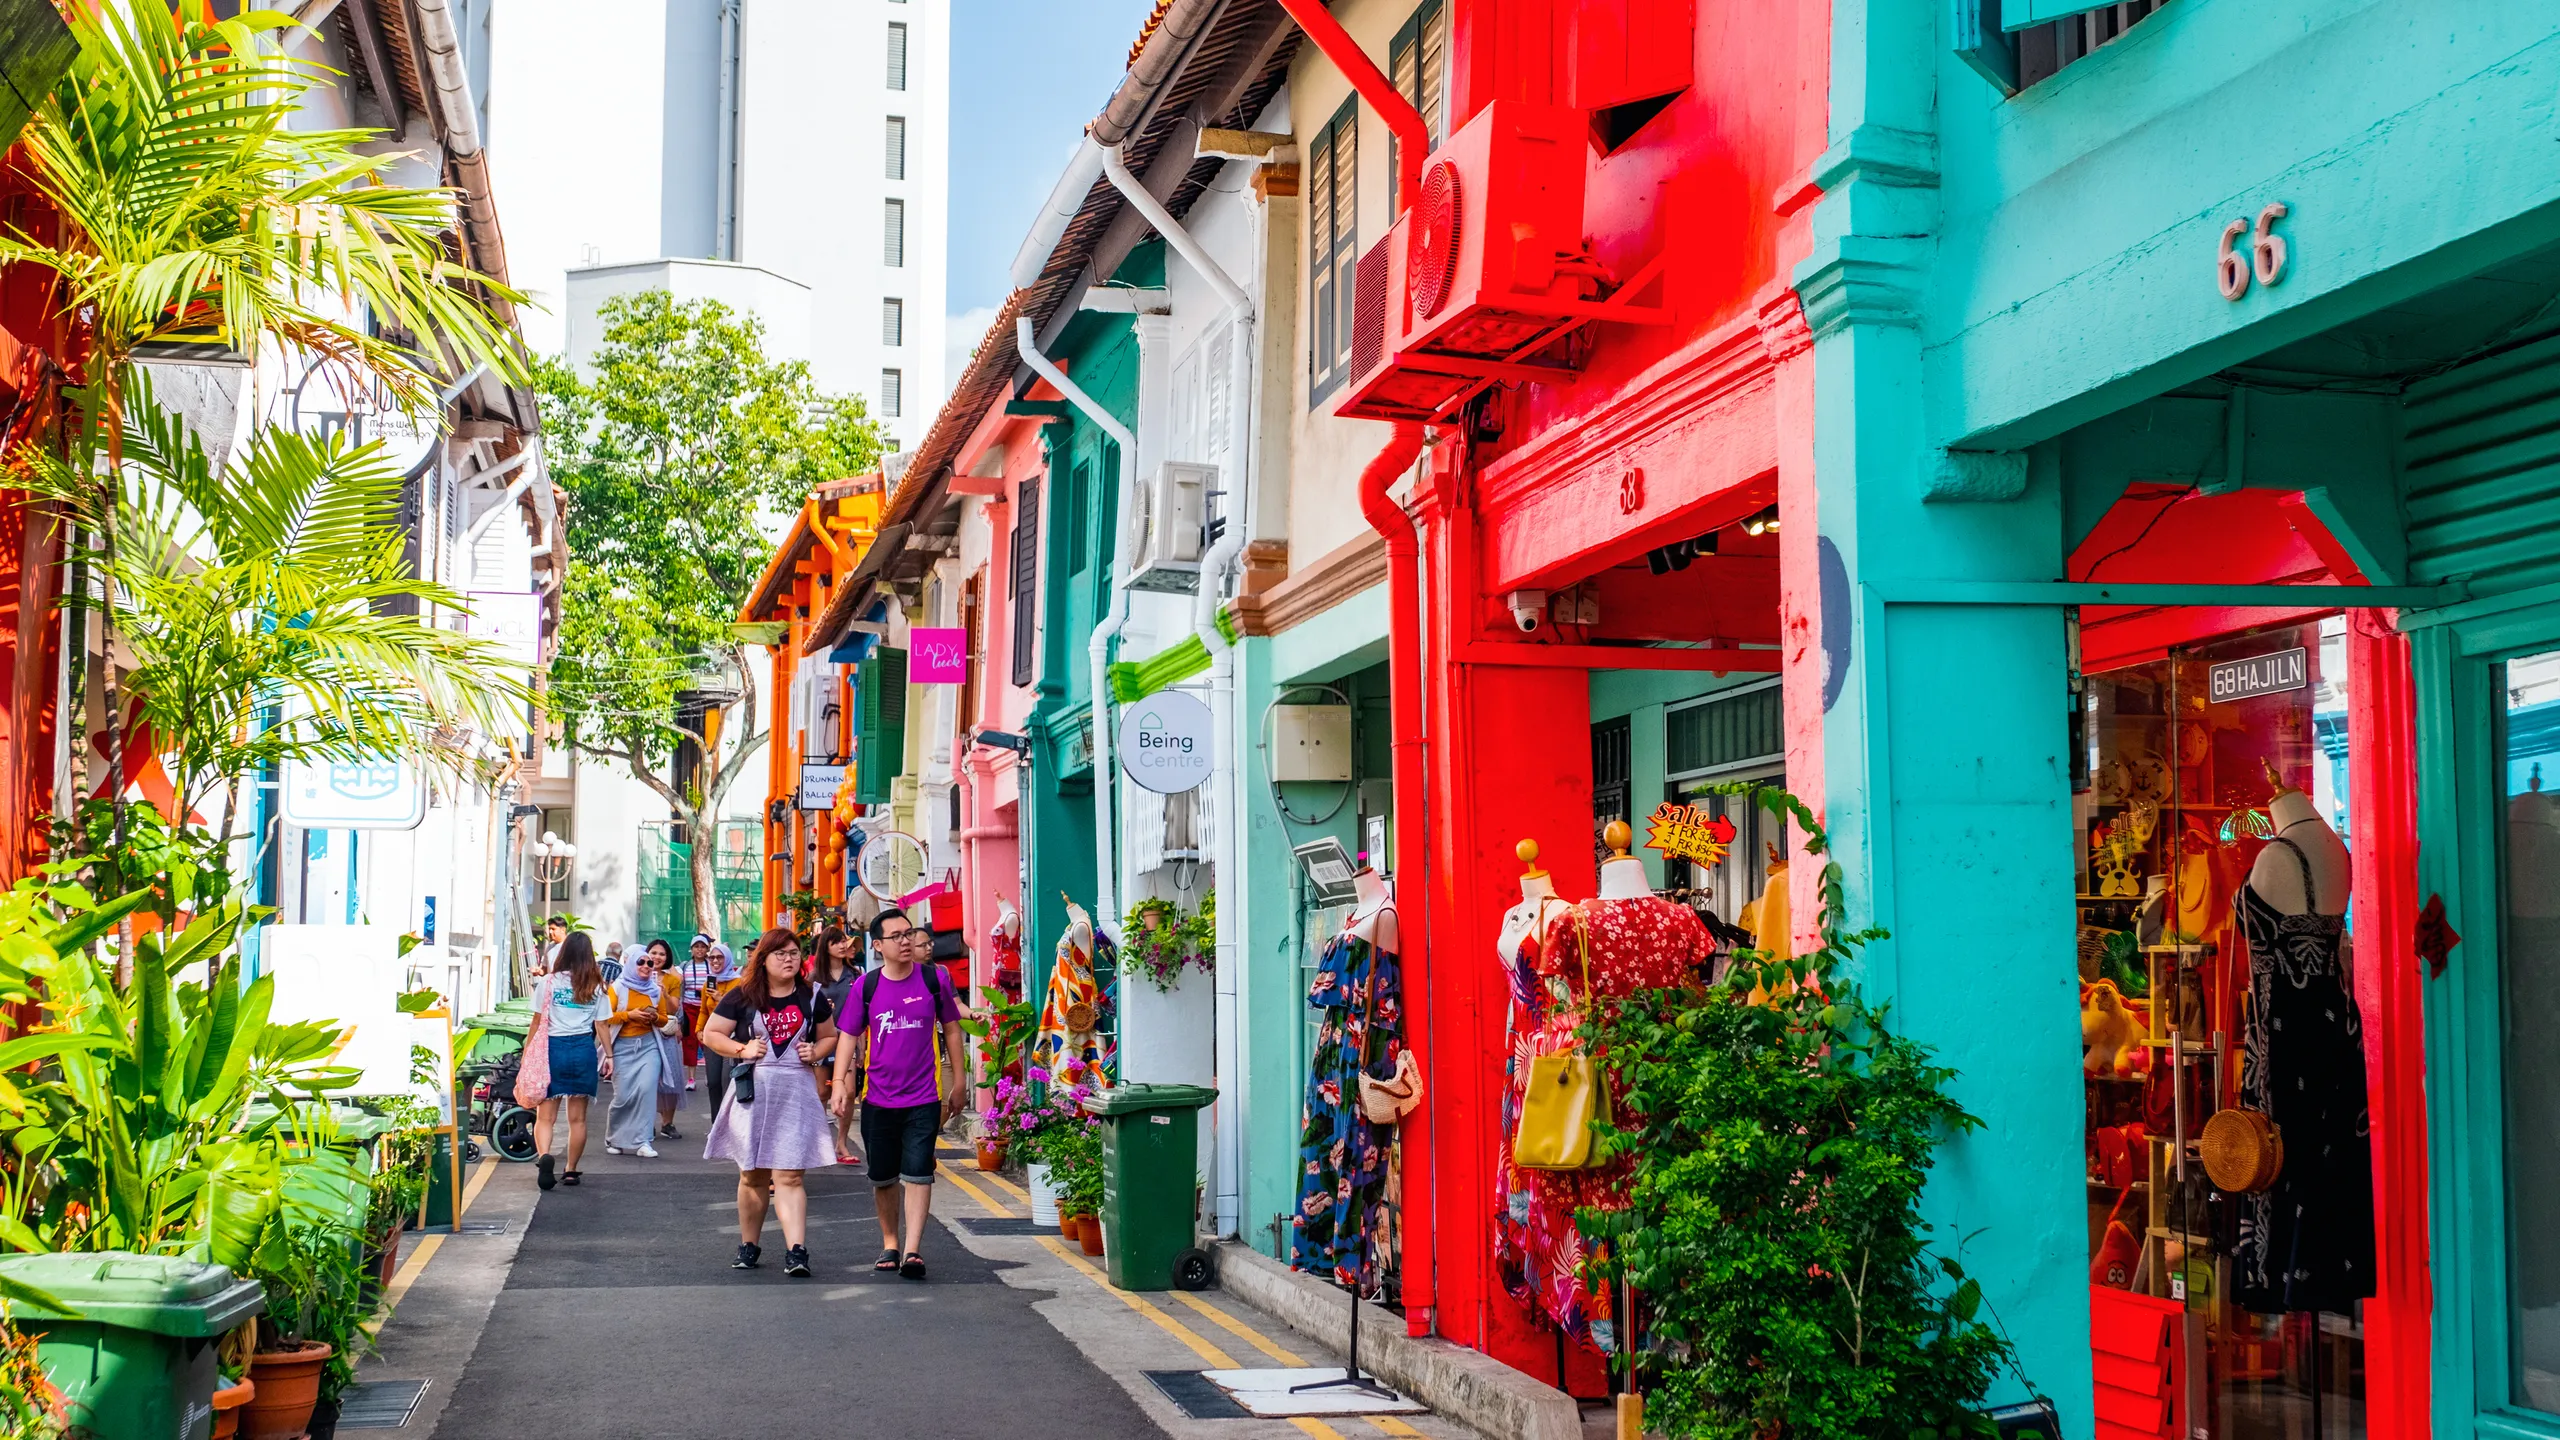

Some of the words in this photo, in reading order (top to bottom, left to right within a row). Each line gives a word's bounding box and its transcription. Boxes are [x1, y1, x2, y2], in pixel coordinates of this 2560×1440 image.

[2217, 202, 2288, 300] 66
[915, 643, 957, 657] LADY
[932, 652, 963, 669] luck
[2214, 654, 2301, 696] 68HAJILN
[1139, 732, 1193, 753] Being
[1139, 751, 1204, 768] Centre
[804, 775, 844, 783] DRUNKEN
[1668, 823, 1676, 836] 1
[1679, 825, 1698, 840] FOR
[1664, 835, 1671, 844] 2
[1677, 837, 1693, 852] FOR
[762, 1011, 798, 1025] PARIS
[771, 1031, 792, 1039] OUR
